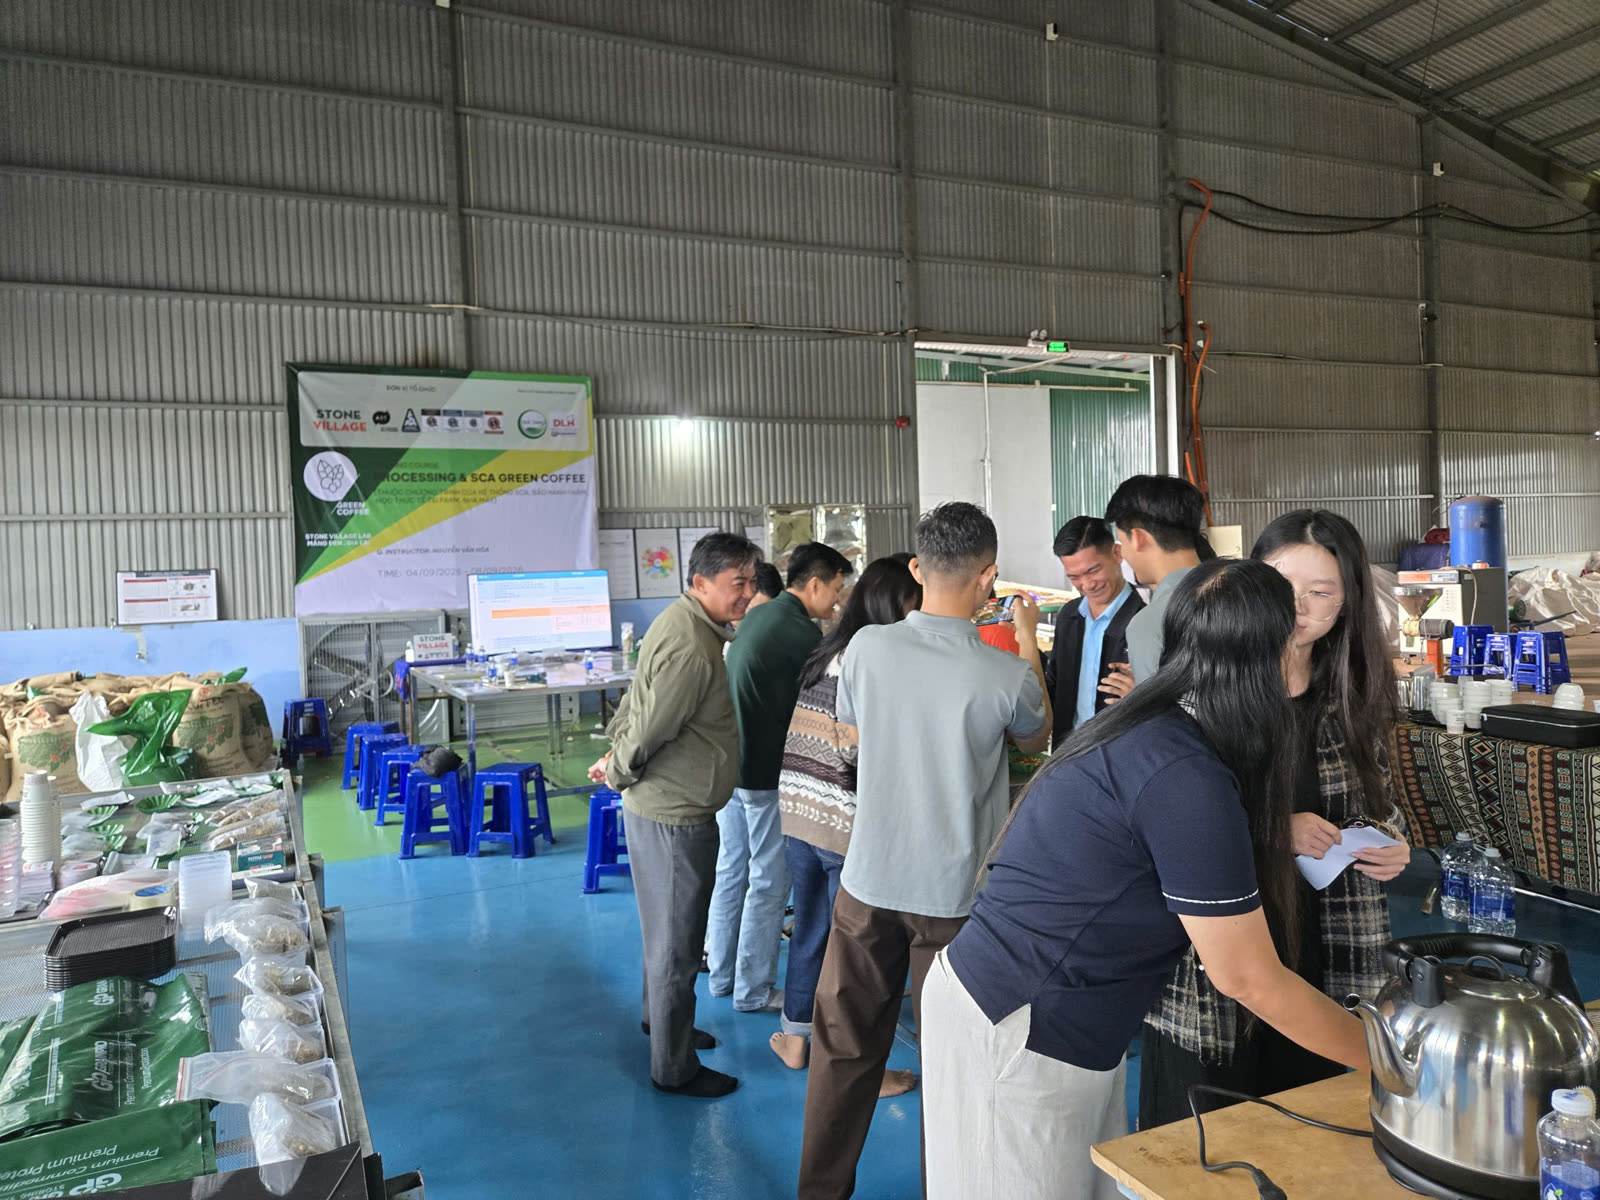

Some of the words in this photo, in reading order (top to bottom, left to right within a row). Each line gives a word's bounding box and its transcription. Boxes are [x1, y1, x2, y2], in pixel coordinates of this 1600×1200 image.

[316, 409, 362, 420] STONE
[313, 421, 367, 432] VILLAGE
[374, 472, 457, 483] OCESSING
[459, 472, 468, 483] &
[470, 473, 496, 483] SCA
[498, 473, 539, 483] GREEN
[540, 473, 586, 484] COFFEE
[336, 501, 366, 509] GREEN
[47, 1144, 118, 1170] Premium
[91, 1146, 160, 1169] Premium
